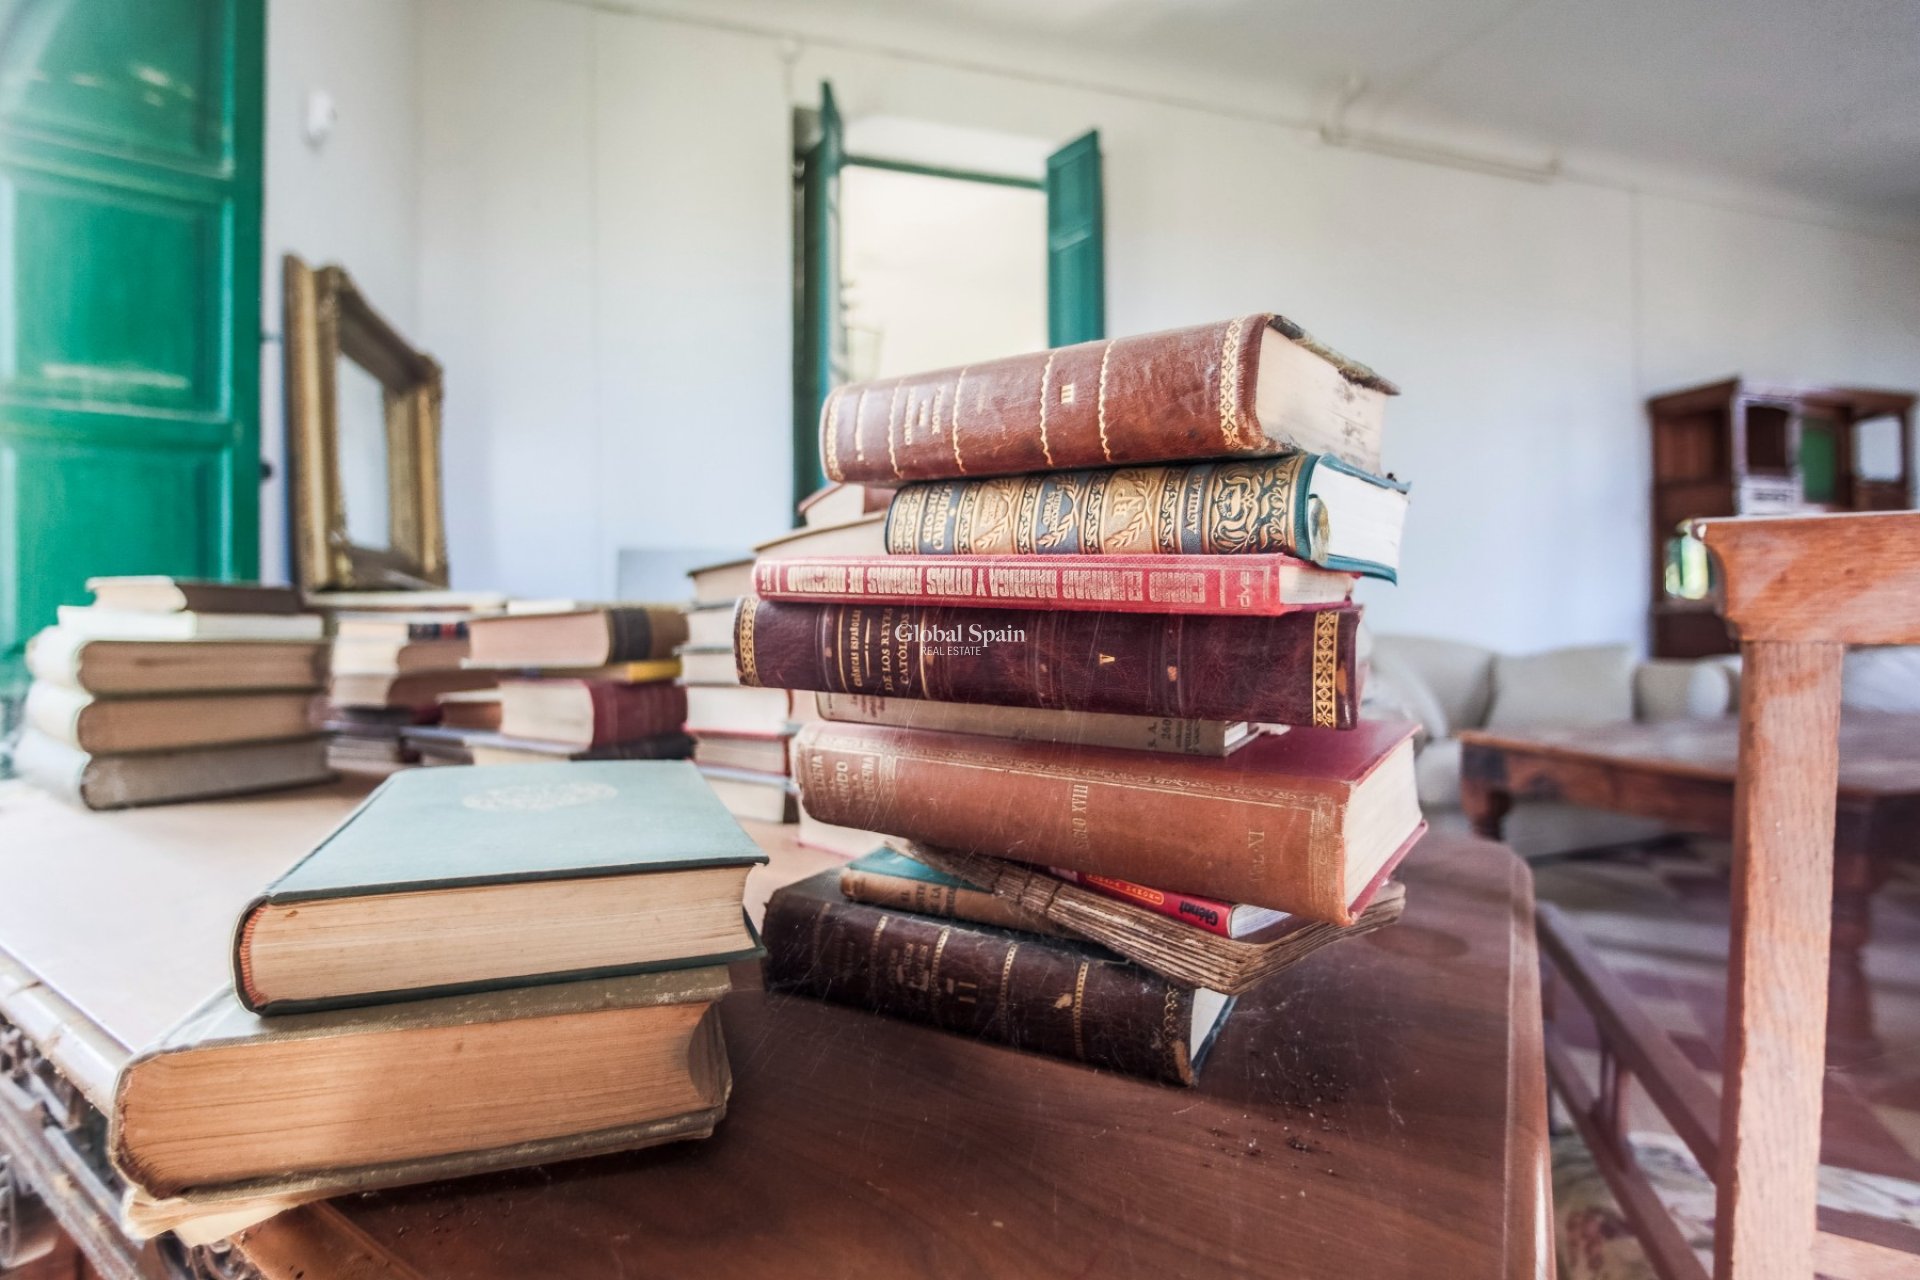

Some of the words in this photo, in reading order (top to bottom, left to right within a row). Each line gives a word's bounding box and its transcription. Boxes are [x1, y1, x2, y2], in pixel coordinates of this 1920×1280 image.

[1060, 383, 1075, 404] III
[847, 567, 864, 594] DE
[867, 567, 922, 596] FORMAS
[926, 568, 973, 596] OTRAS
[973, 570, 988, 597] Y
[989, 568, 1057, 598] BARRIGA
[1062, 570, 1143, 603] ELIMINAR
[881, 648, 891, 672] LOS
[1099, 653, 1115, 665] V
[882, 675, 894, 692] DE
[1071, 783, 1089, 814] XVIII
